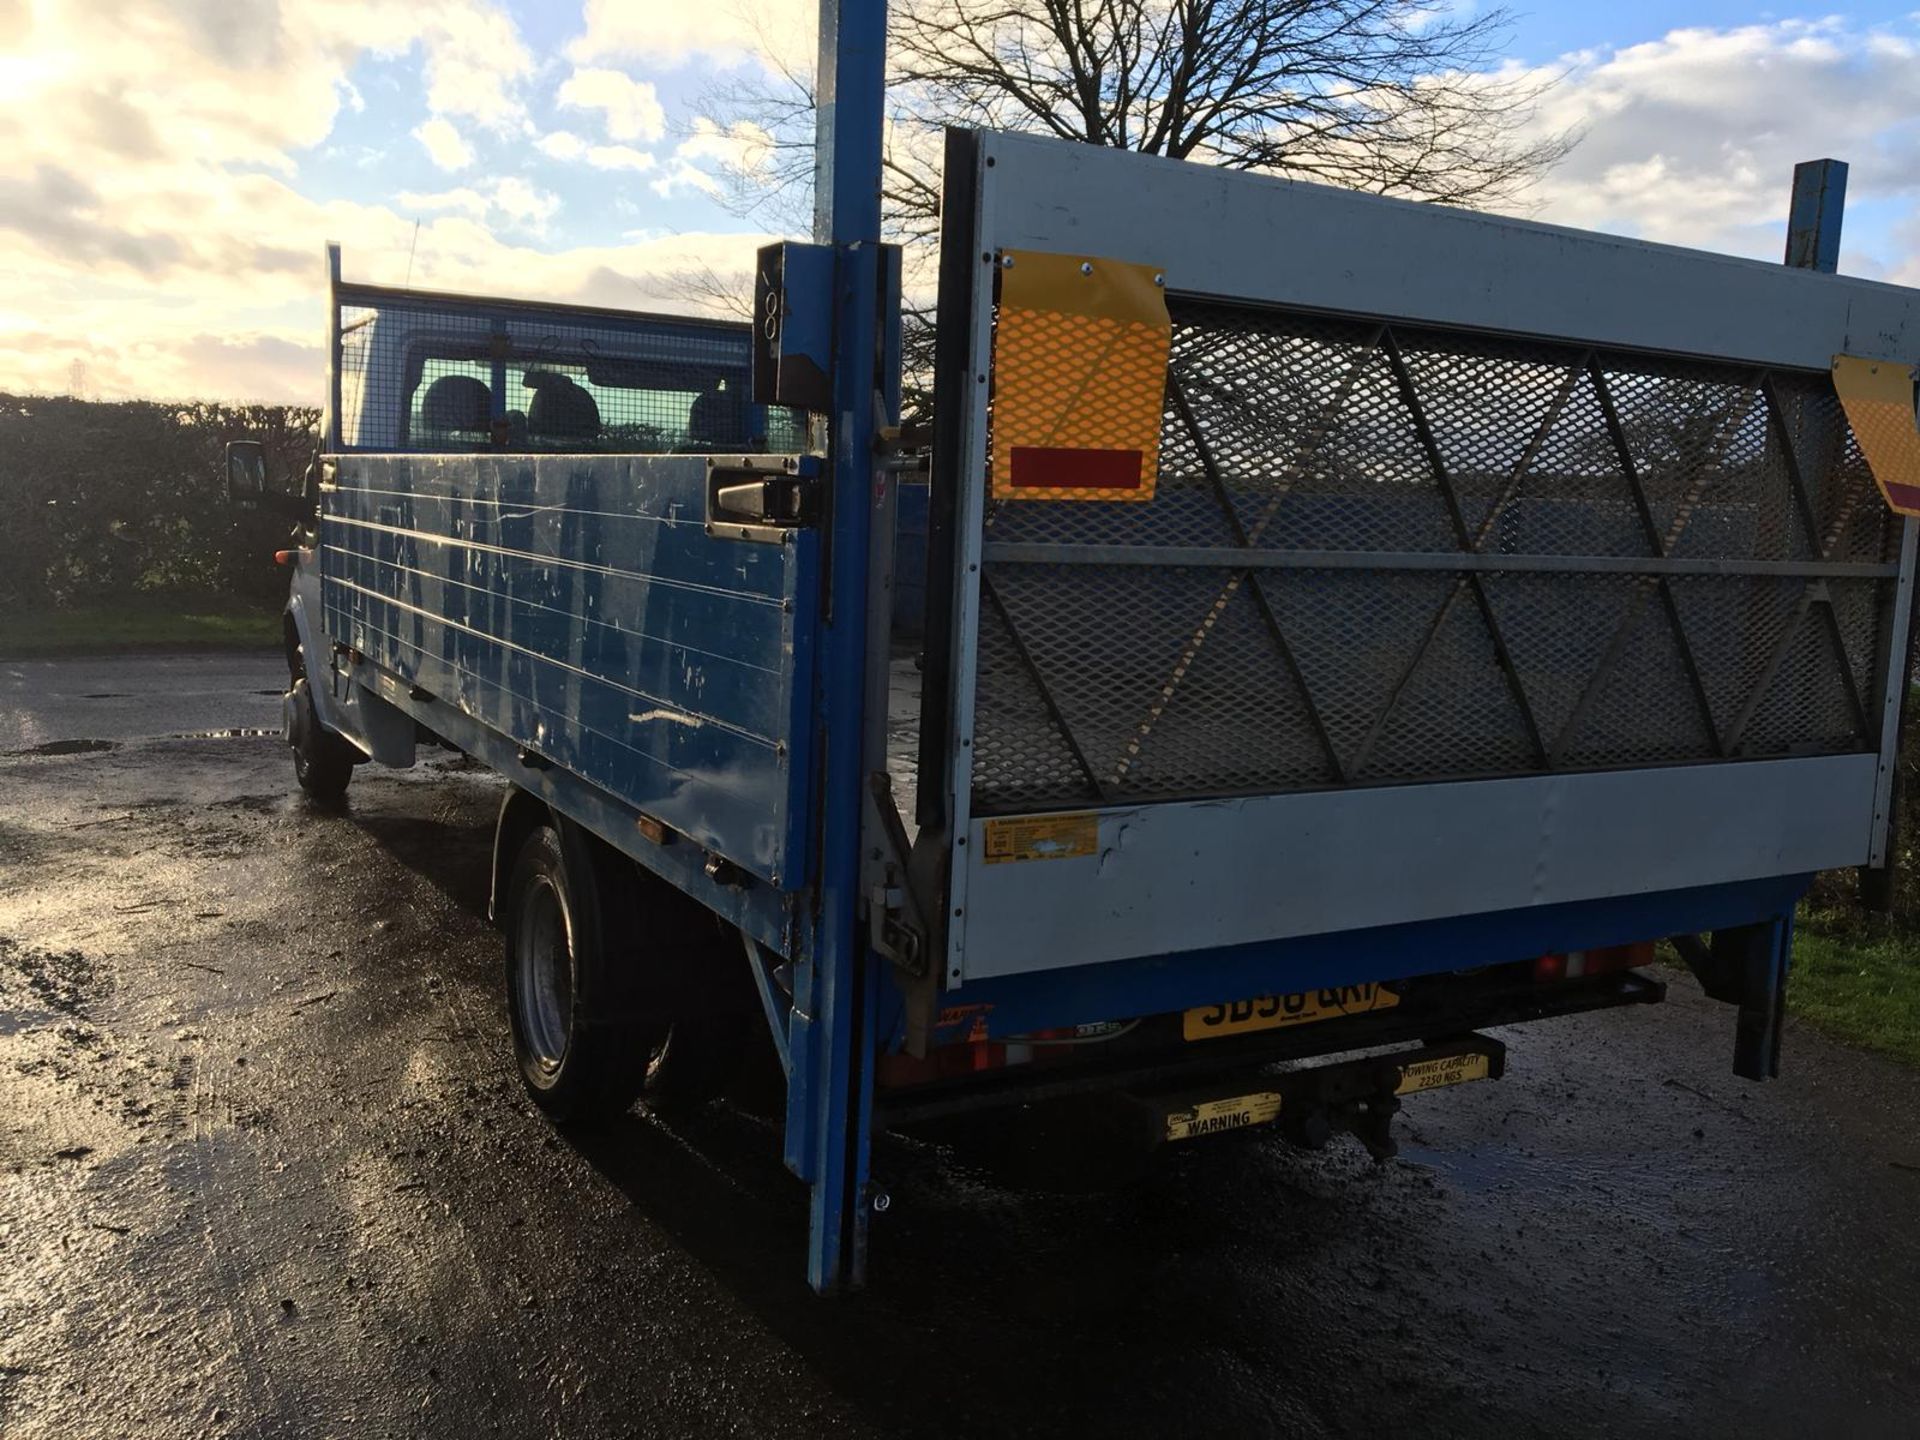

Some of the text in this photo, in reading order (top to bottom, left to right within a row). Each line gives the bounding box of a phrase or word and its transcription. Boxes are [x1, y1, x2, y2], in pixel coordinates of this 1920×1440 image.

[1440, 1056, 1480, 1071] CAPACITY
[1419, 1071, 1462, 1087] 2250 KGS
[1187, 1111, 1250, 1134] WARNING
